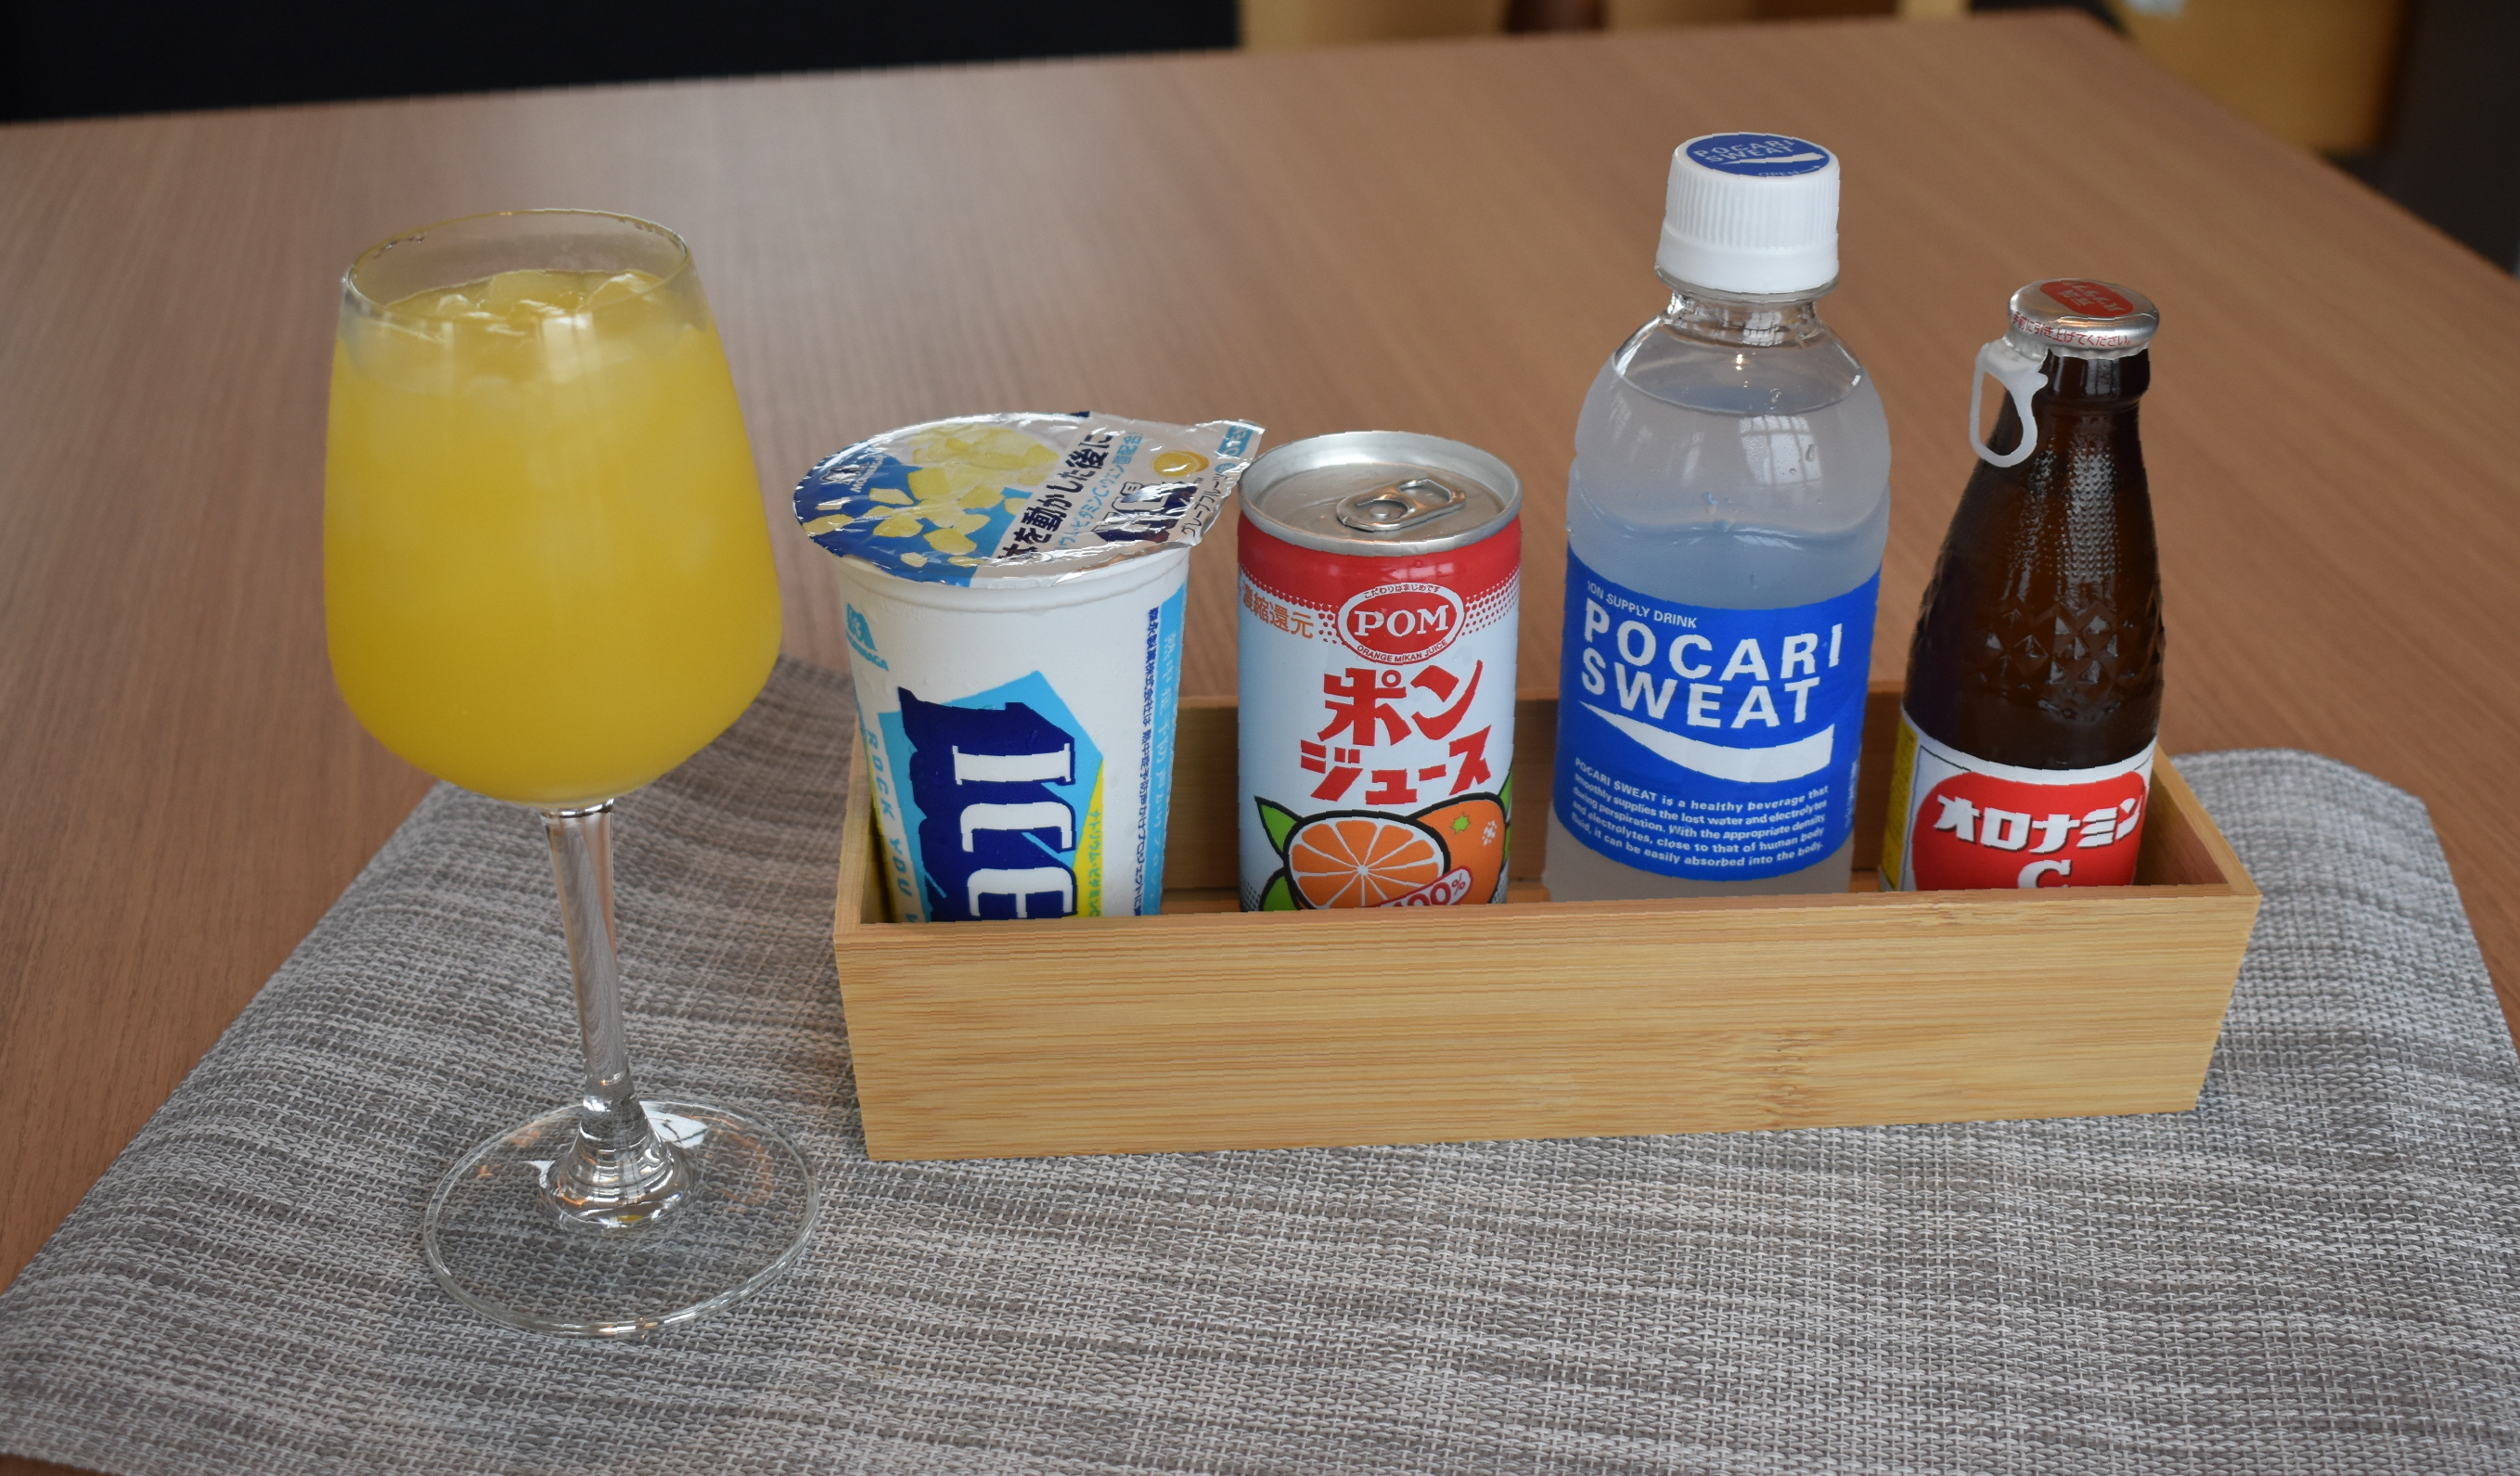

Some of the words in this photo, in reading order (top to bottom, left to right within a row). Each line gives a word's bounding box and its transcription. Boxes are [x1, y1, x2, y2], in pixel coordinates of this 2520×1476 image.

[1693, 138, 1794, 158] POCARI
[1705, 146, 1794, 162] SWEAT
[1364, 584, 1441, 599] こだわりはまじめです
[1588, 581, 1604, 599] ION
[1607, 593, 1650, 617] SUPPLY
[1653, 610, 1697, 629] DRINK
[1354, 604, 1449, 638] POM
[1584, 597, 1843, 681] POCARI
[1356, 645, 1393, 662] ORANGE
[1394, 651, 1422, 662] MIKAN
[1424, 639, 1448, 658] JUICE
[1318, 660, 1483, 746] ポン
[1581, 648, 1820, 729] SWEAT
[1300, 725, 1492, 805] ジュース
[1575, 757, 1611, 786] POCARI
[1614, 780, 1657, 802] SWEAT
[1662, 795, 1674, 806] is
[1678, 800, 1686, 808] a
[1691, 801, 1742, 814] healthy
[1747, 795, 1806, 812] beverage
[1808, 785, 1829, 799] that
[1575, 774, 1613, 802] smoothly
[1614, 796, 1657, 816] supplies
[1659, 809, 1678, 821] the
[1681, 813, 1705, 824] lost
[1707, 815, 1743, 826] water
[1745, 814, 1767, 825] and
[1768, 800, 1827, 822] electrolytes
[1599, 803, 1665, 833] perspiration.
[1669, 824, 1697, 838] With
[1700, 828, 1720, 840] the
[1723, 824, 1790, 841] appropriate
[1792, 814, 1826, 832] density
[1933, 794, 2144, 854] オロナミン
[952, 742, 1074, 919] ICE
[1573, 801, 1587, 815] and
[1588, 811, 1653, 845] electrolytes,
[1656, 838, 1691, 851] close
[1694, 843, 1709, 853] to
[1712, 843, 1739, 854] that
[1742, 842, 1756, 853] of
[1759, 837, 1798, 851] human
[1800, 827, 1824, 842] body
[1594, 827, 1601, 839] it
[1604, 835, 1623, 848] can
[1626, 841, 1641, 854] be
[1643, 848, 1681, 865] easily
[1684, 855, 1745, 867] absorbed
[1749, 855, 1773, 866] into
[1776, 851, 1795, 861] the
[1798, 841, 1823, 857] body.
[1394, 873, 1466, 906] 00%
